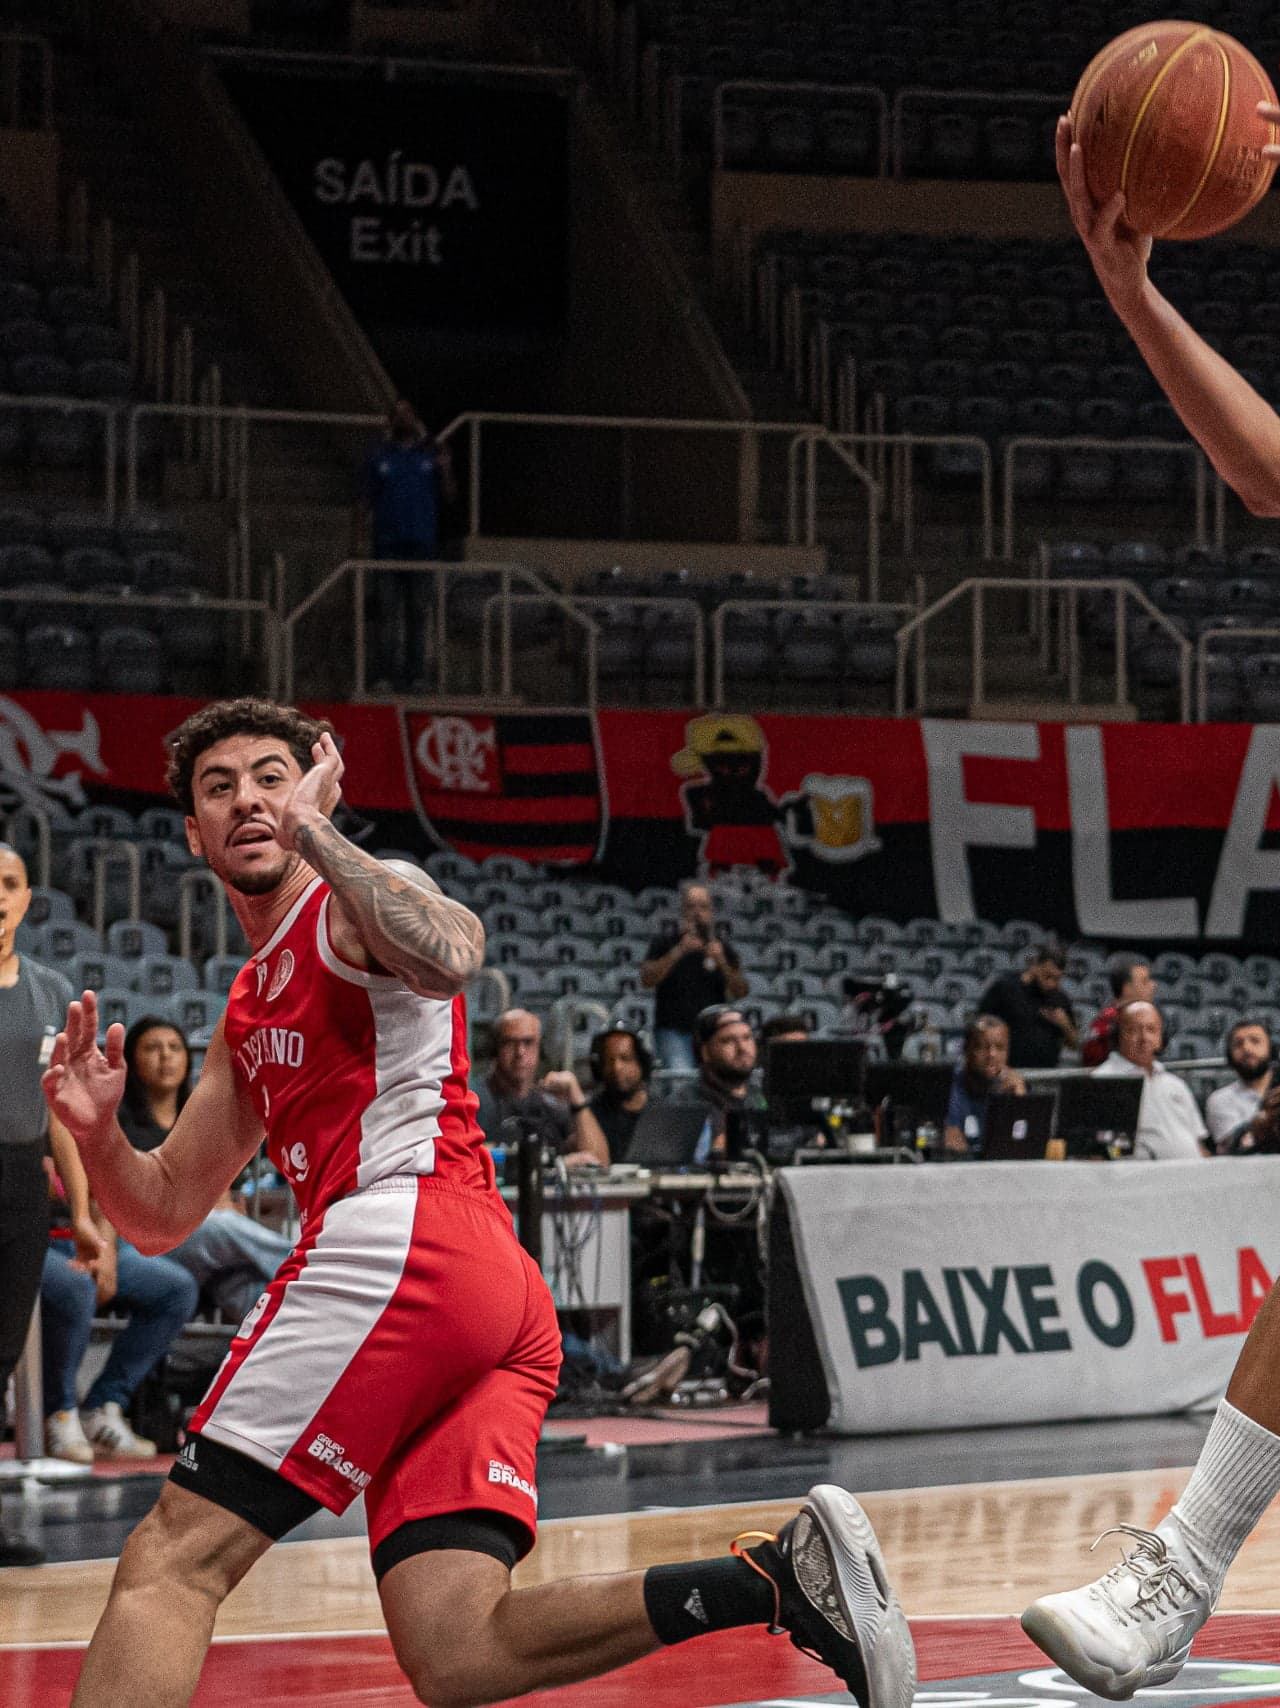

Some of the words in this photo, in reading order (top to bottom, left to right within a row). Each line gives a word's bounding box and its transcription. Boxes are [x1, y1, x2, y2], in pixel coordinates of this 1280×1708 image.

[314, 151, 480, 209] SAÍDA
[351, 216, 443, 263] Exit
[836, 1264, 1073, 1369] BAIXE
[1077, 1259, 1135, 1348] O
[317, 1433, 345, 1455] GRUPO
